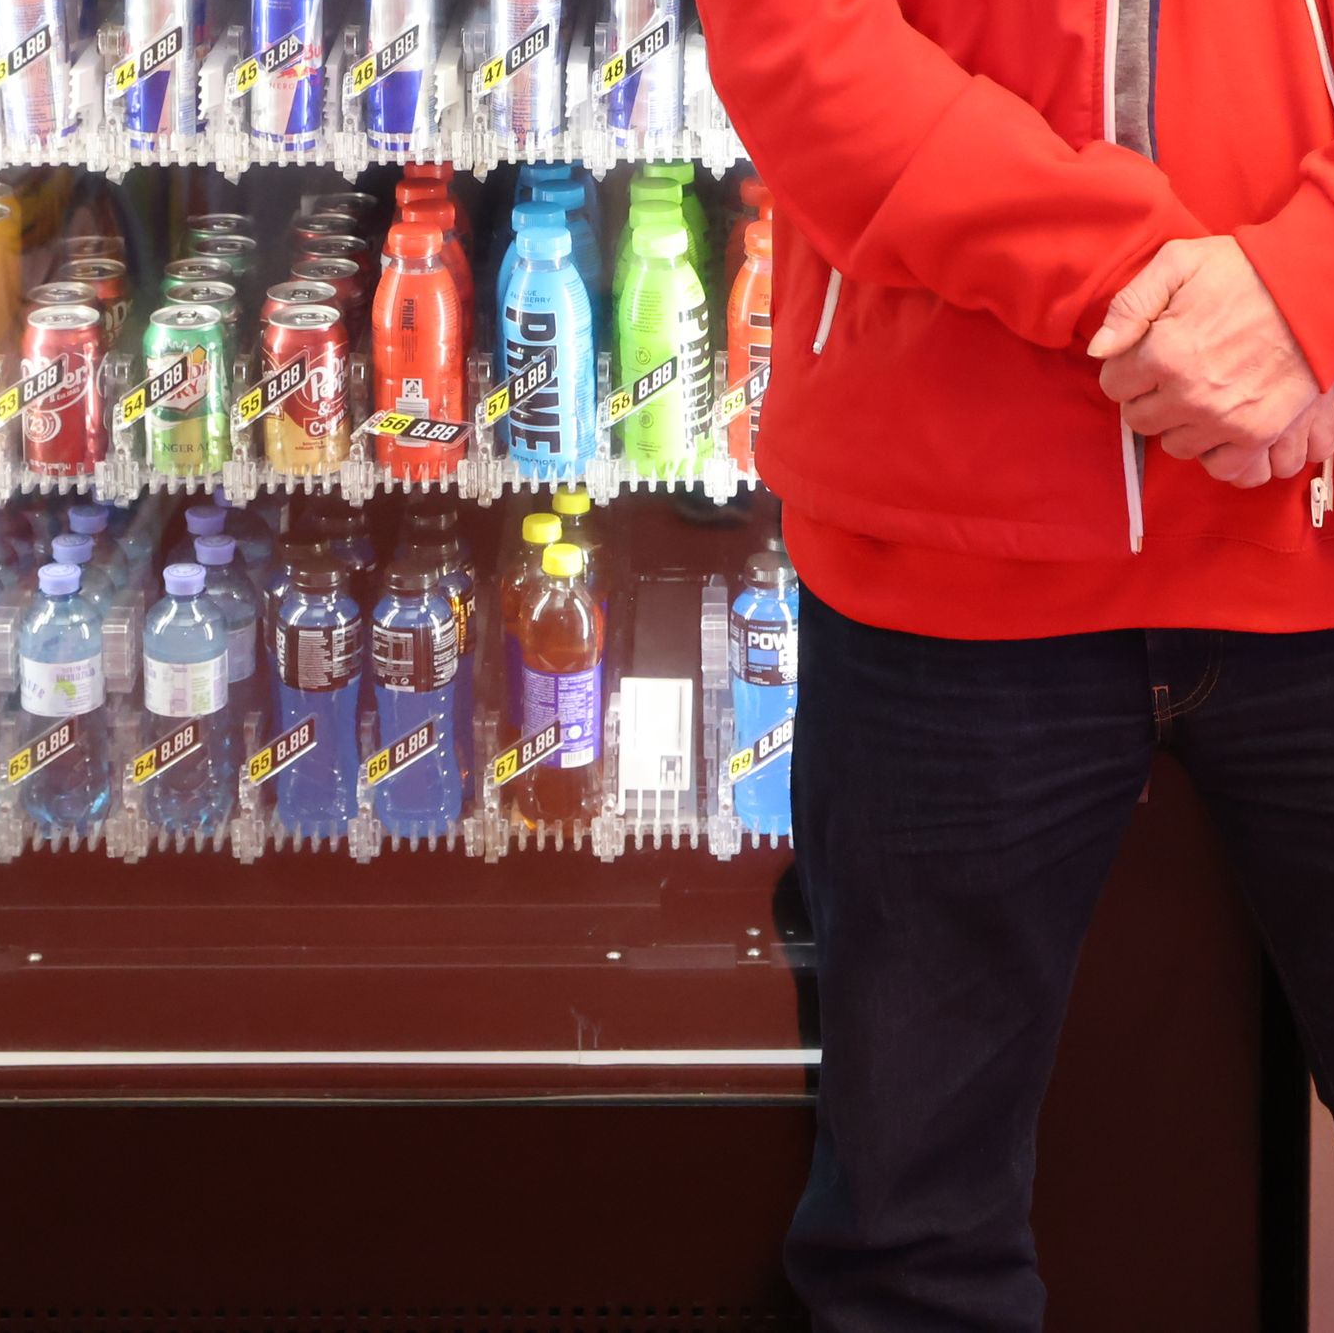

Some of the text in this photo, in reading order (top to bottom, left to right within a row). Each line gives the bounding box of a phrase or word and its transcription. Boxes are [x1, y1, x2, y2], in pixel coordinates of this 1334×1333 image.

[11, 30, 47, 72] 8.88
[115, 32, 177, 87] 44 8.88
[353, 31, 416, 87] 46 8.88
[483, 29, 544, 87] 47 8.88
[603, 58, 624, 85] 48
[237, 62, 258, 87] 45
[23, 364, 58, 403] 8.88
[123, 364, 184, 419] 54 8.88
[240, 363, 301, 418] 55 8.88
[487, 361, 548, 416] 57 8.88
[610, 361, 673, 417] 58 8.88
[379, 415, 458, 442] 56 8.88
[9, 724, 70, 778] 63 8.88
[160, 724, 194, 763] 8.88
[276, 724, 309, 762] 8.88
[394, 726, 428, 764] 8.88
[522, 725, 556, 762] 8.88
